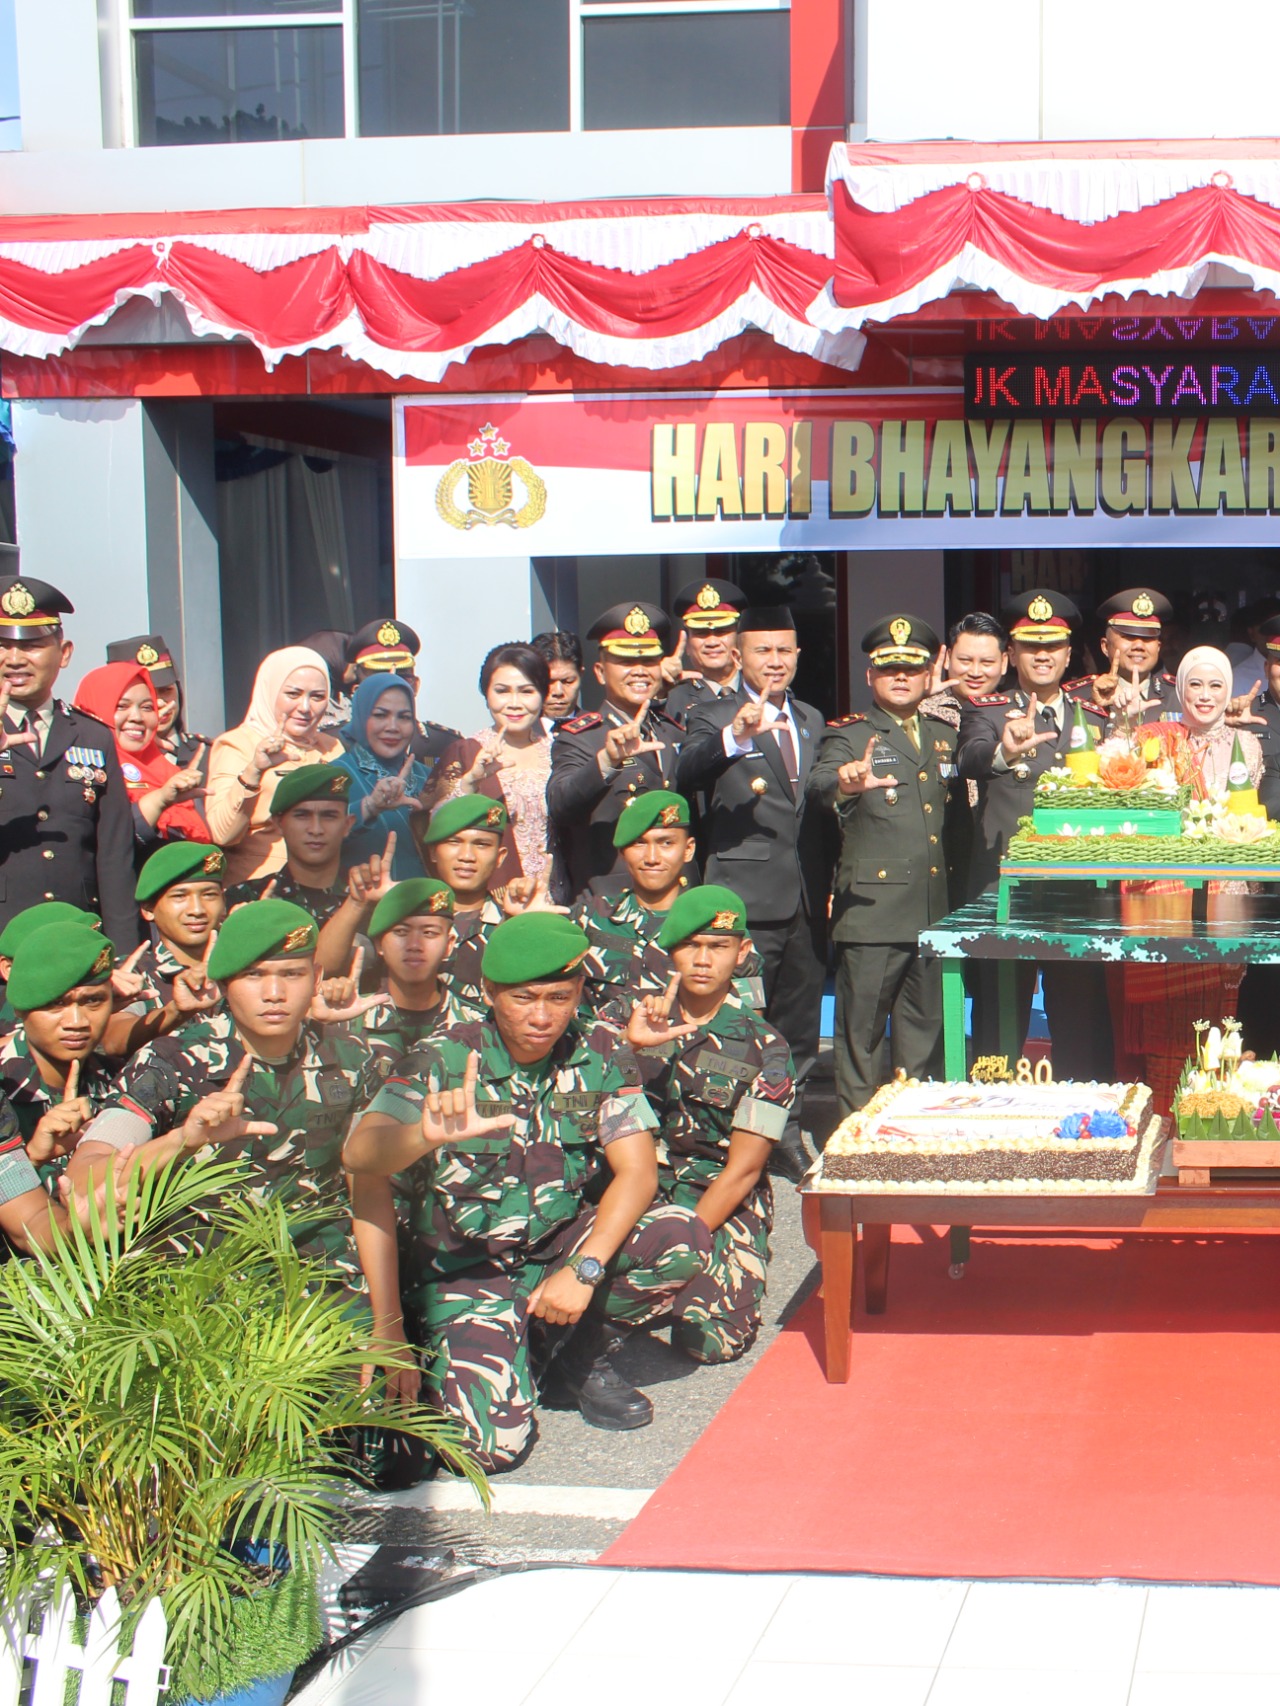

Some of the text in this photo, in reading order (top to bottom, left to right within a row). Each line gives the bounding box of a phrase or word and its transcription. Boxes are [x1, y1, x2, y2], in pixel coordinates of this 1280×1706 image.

[650, 420, 813, 523] HARI
[708, 1058, 728, 1072] TNI
[1016, 1057, 1053, 1085] 80
[563, 1096, 588, 1108] TNI
